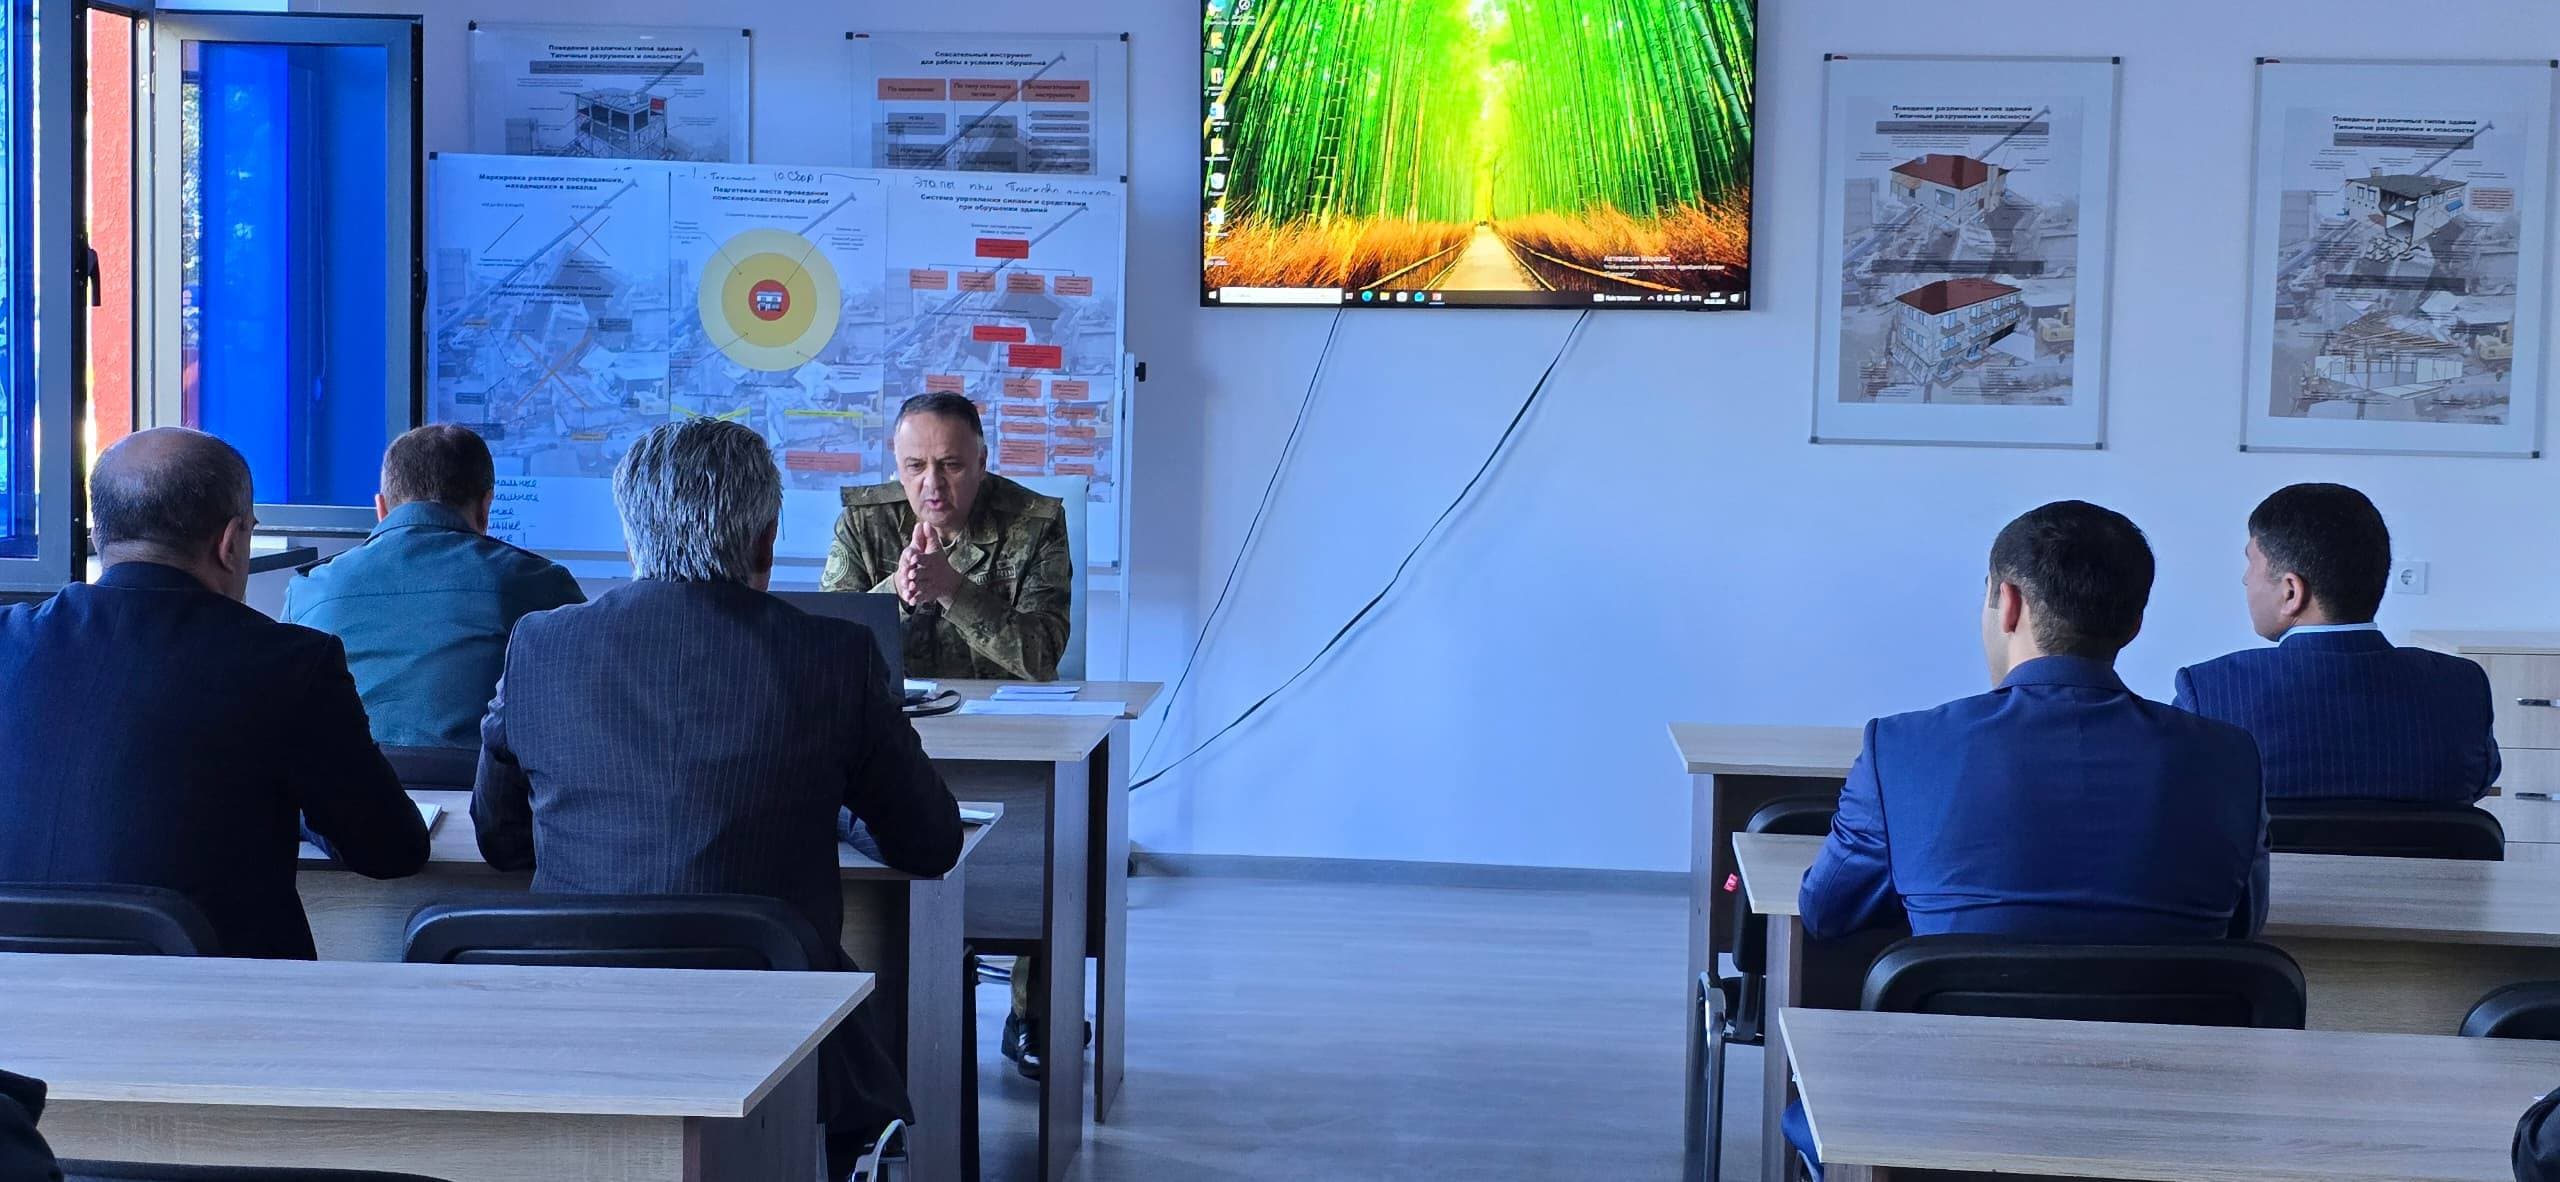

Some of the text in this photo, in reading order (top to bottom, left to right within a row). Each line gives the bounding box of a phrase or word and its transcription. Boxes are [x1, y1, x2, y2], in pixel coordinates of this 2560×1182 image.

[548, 44, 589, 52] Поведение
[479, 173, 526, 182] Маркировка
[566, 176, 624, 184] пострадавших,
[714, 186, 829, 198] Подготовка места проведения
[712, 194, 830, 206] поисково-спасательных работ
[920, 193, 954, 202] Система
[956, 196, 1001, 204] управления
[1041, 200, 1086, 208] средствами
[1020, 206, 1048, 214] зданий
